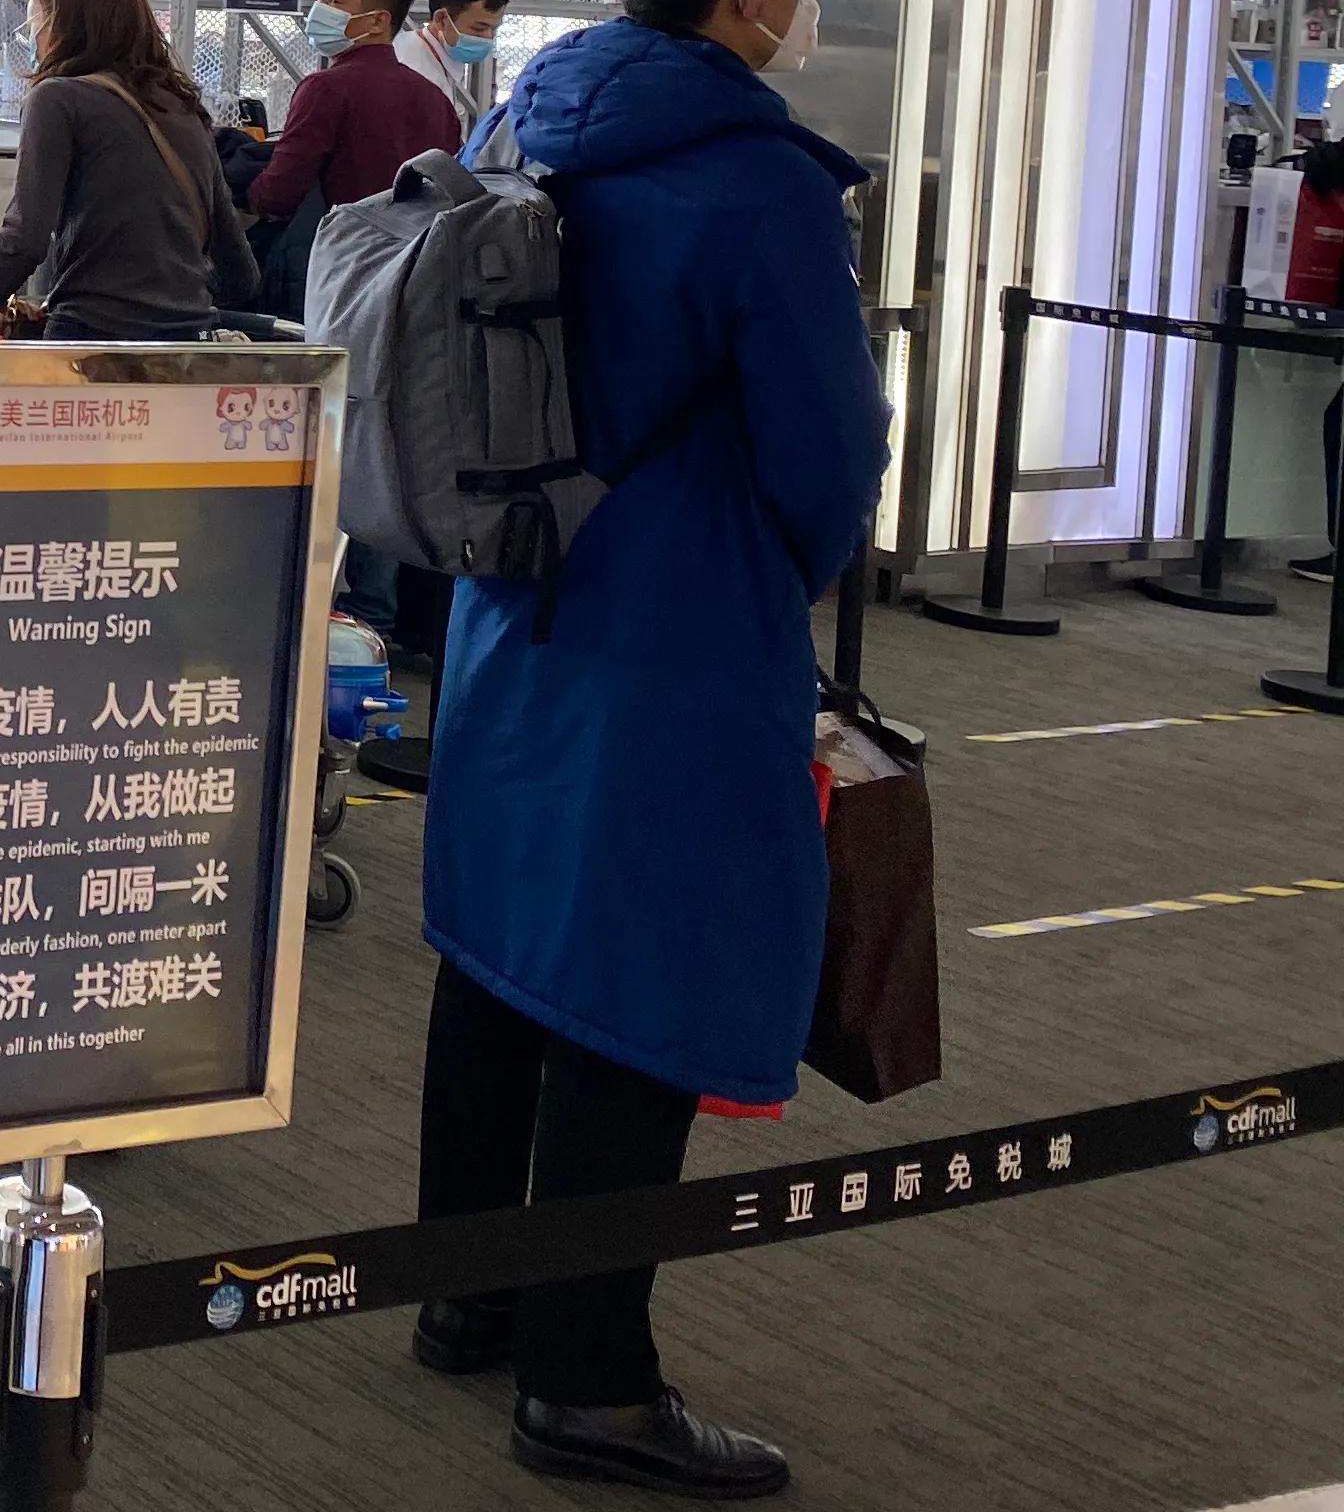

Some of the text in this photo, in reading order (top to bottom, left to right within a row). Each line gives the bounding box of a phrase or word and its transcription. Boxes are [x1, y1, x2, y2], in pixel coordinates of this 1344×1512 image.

[8, 612, 152, 645] Warning Sign
[102, 743, 120, 759] to
[123, 739, 160, 762] fight
[163, 737, 189, 756] the
[192, 733, 260, 757] epidemic
[8, 837, 82, 864] epidemic,
[87, 833, 146, 854] starting
[150, 830, 183, 848] with
[186, 831, 210, 847] me
[43, 931, 104, 953] fashion,
[107, 930, 137, 945] one
[139, 924, 184, 941] meter
[186, 918, 228, 941] apart
[5, 1037, 24, 1056] all
[28, 1036, 43, 1054] in
[47, 1033, 75, 1052] this
[79, 1026, 145, 1051] together
[1227, 1096, 1296, 1134] cdfmall
[731, 1131, 1073, 1231] 三亚国际免税城
[256, 1264, 358, 1309] cdfmall
